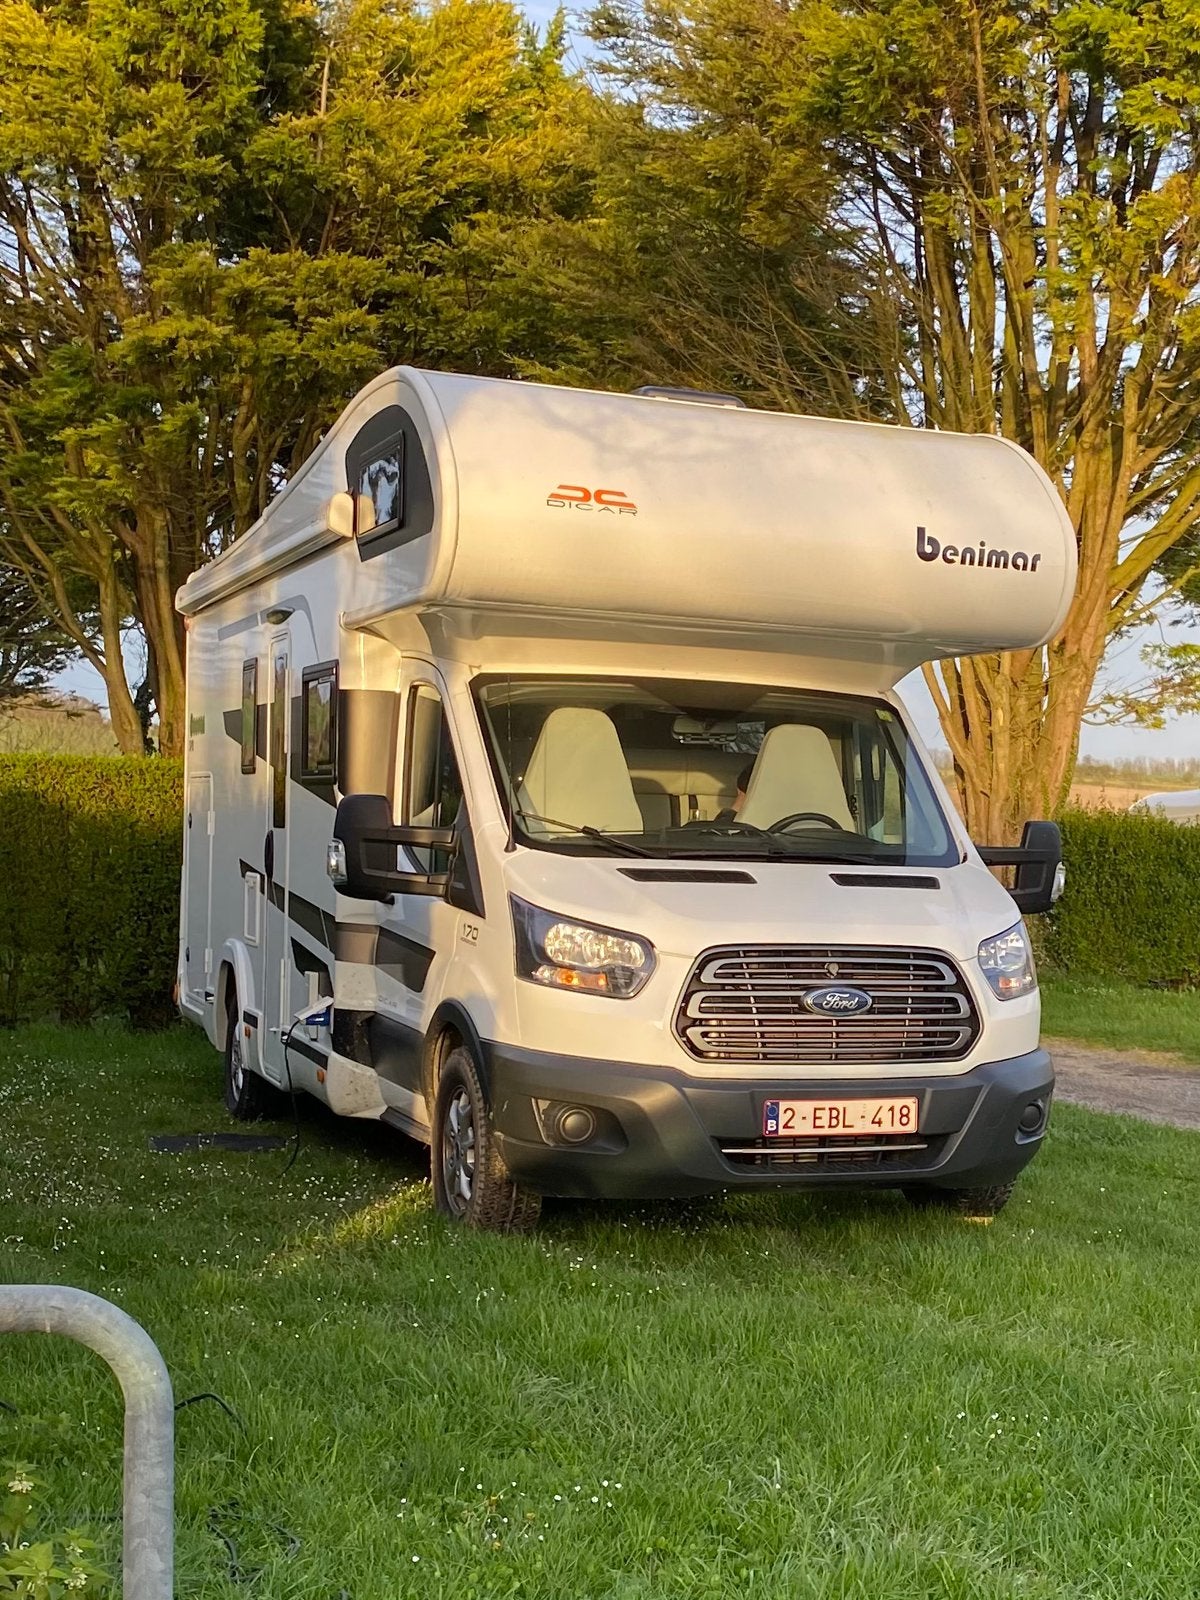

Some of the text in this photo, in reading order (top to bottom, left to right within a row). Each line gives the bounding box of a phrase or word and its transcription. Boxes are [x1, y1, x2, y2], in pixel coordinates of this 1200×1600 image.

[546, 499, 638, 516] DICAR
[916, 526, 1041, 572] benimar
[463, 923, 479, 940] 170
[822, 992, 859, 1010] Ford
[767, 1120, 777, 1131] B
